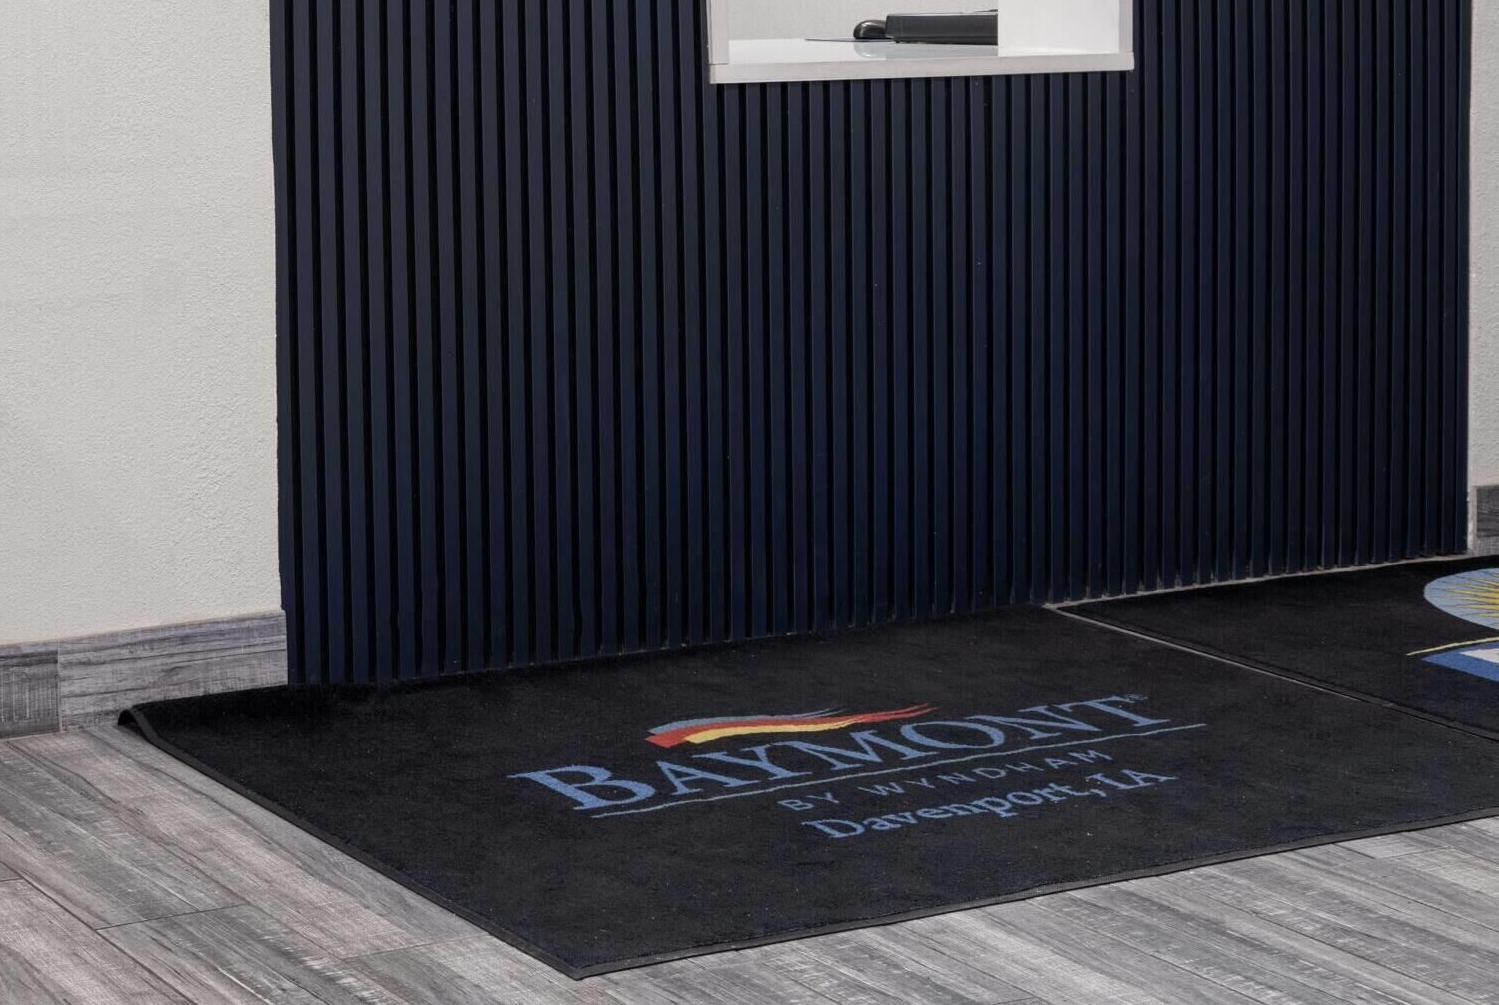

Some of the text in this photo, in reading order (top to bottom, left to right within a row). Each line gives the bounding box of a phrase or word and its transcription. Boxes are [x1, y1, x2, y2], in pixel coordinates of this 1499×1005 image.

[507, 695, 1171, 810] BAYMONT
[777, 748, 1113, 811] BY WYNDHAM
[802, 768, 1177, 840] Davenport, IA
